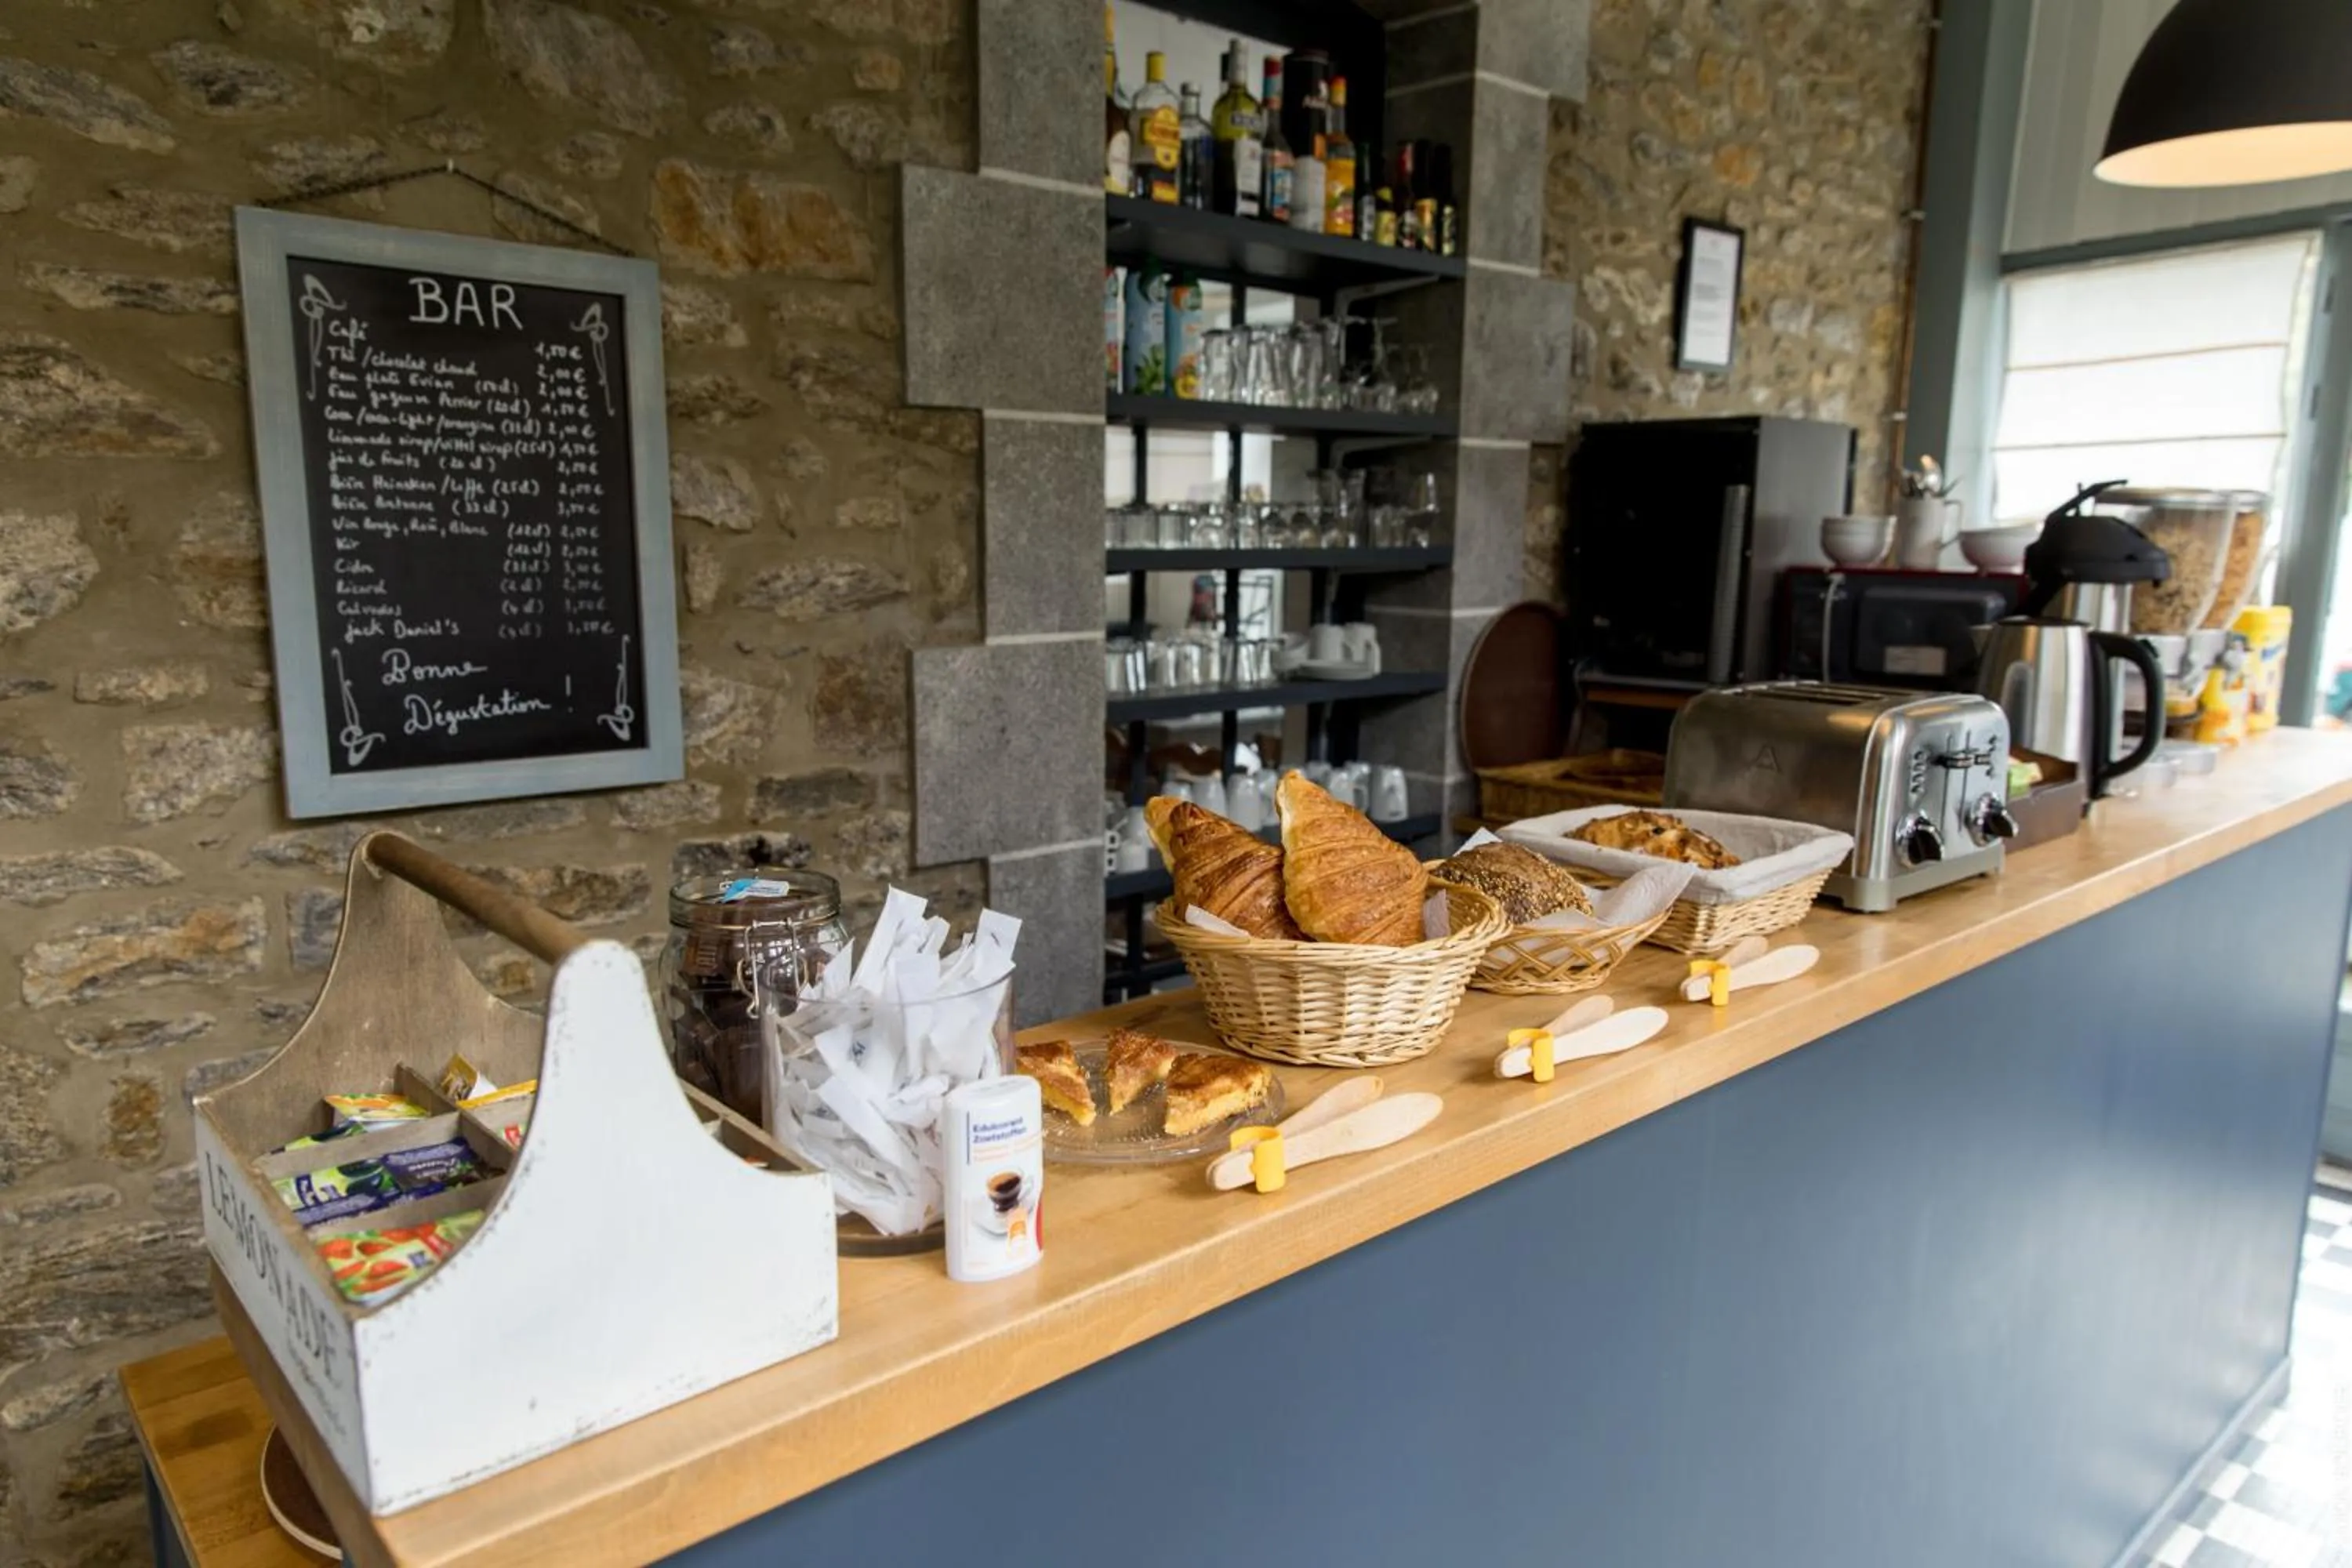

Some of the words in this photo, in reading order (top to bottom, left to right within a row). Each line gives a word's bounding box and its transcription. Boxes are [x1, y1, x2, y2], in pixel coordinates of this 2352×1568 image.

[408, 277, 524, 330] BAR
[328, 318, 368, 347] Café
[332, 516, 359, 531] Vin
[381, 648, 488, 686] Bonne
[404, 688, 551, 735] Dégustation
